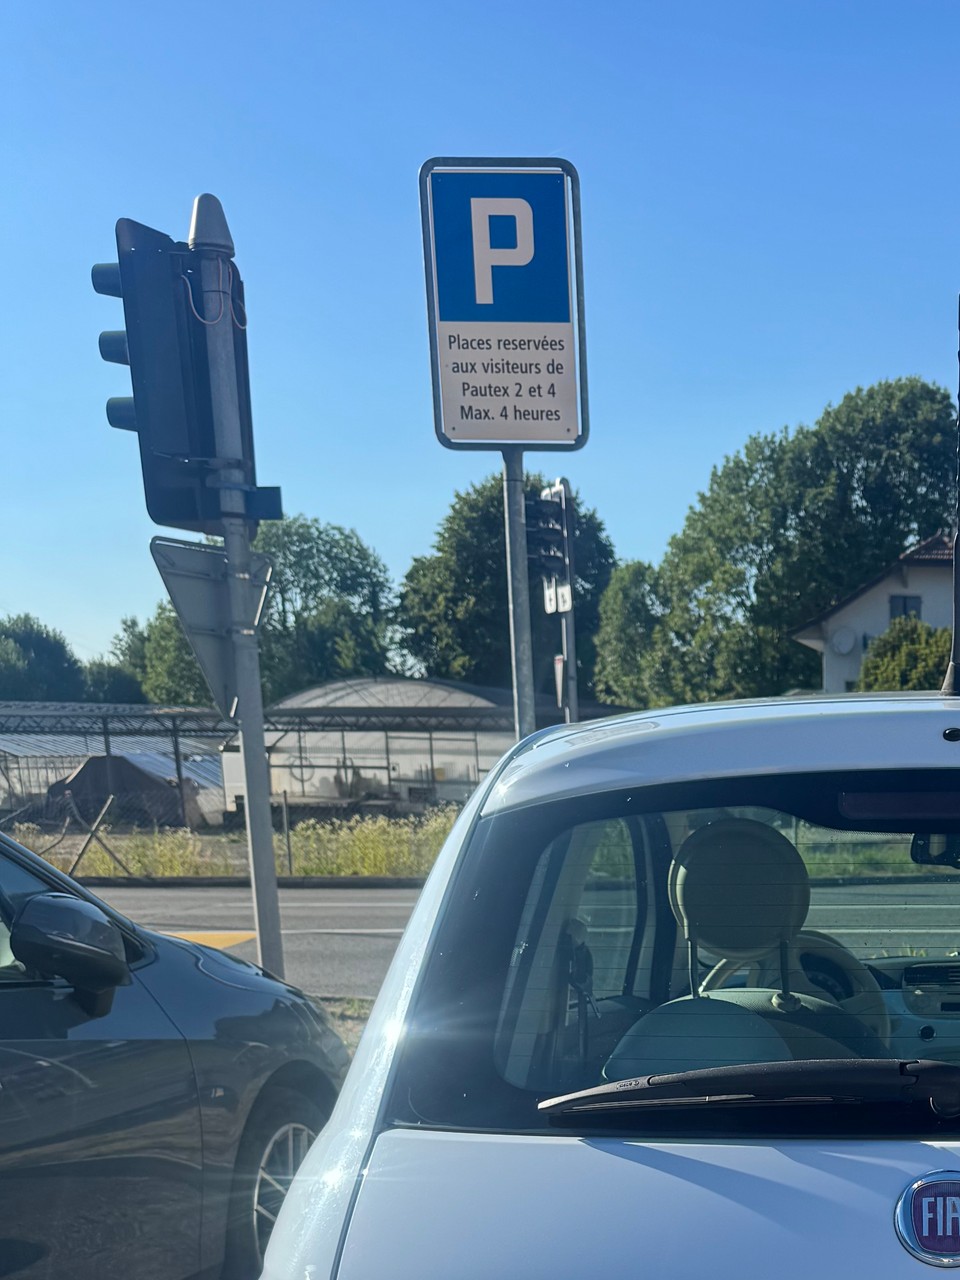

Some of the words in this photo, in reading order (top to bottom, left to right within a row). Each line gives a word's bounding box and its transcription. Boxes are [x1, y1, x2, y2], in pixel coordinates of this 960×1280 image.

[470, 197, 536, 305] P
[447, 334, 493, 351] Places
[496, 335, 566, 352] reservées
[451, 361, 478, 375] aux
[482, 358, 542, 376] visiteurs
[545, 358, 565, 376] de
[461, 382, 511, 399] Pautex
[514, 382, 524, 398] 2
[528, 383, 544, 399] et
[547, 382, 557, 399] 4
[459, 405, 496, 421] Max.
[499, 405, 509, 421] 4
[513, 405, 562, 422] heures
